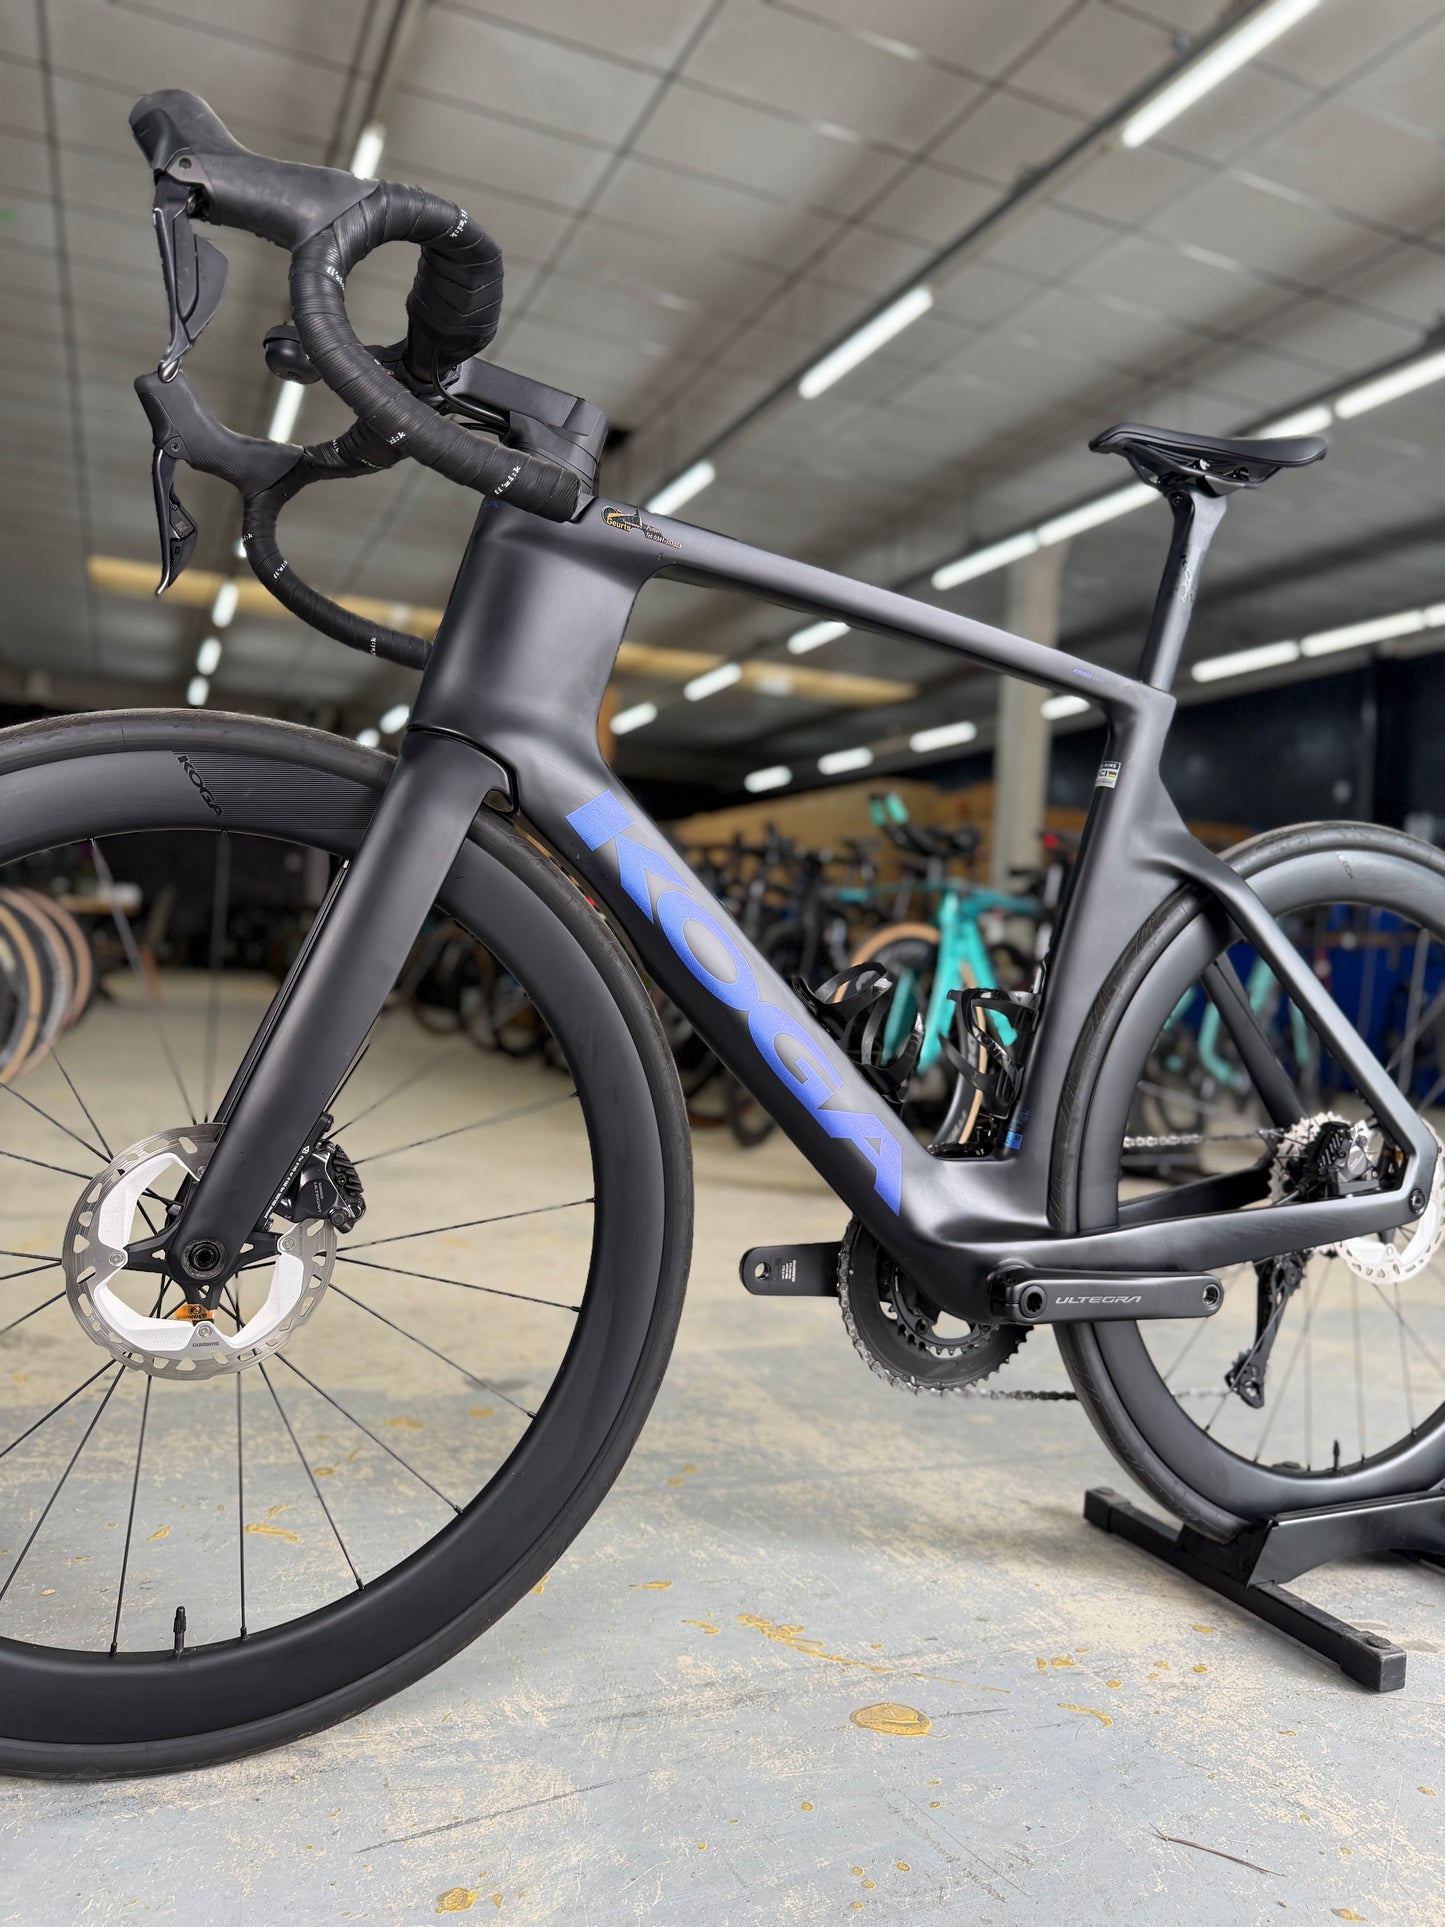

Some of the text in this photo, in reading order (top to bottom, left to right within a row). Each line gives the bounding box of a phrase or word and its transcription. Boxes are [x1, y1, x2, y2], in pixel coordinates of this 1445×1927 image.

[606, 517, 631, 532] Geurts
[177, 754, 223, 816] KOGA
[565, 790, 903, 1217] KOGA
[1055, 1295, 1142, 1304] ULTEGRA
